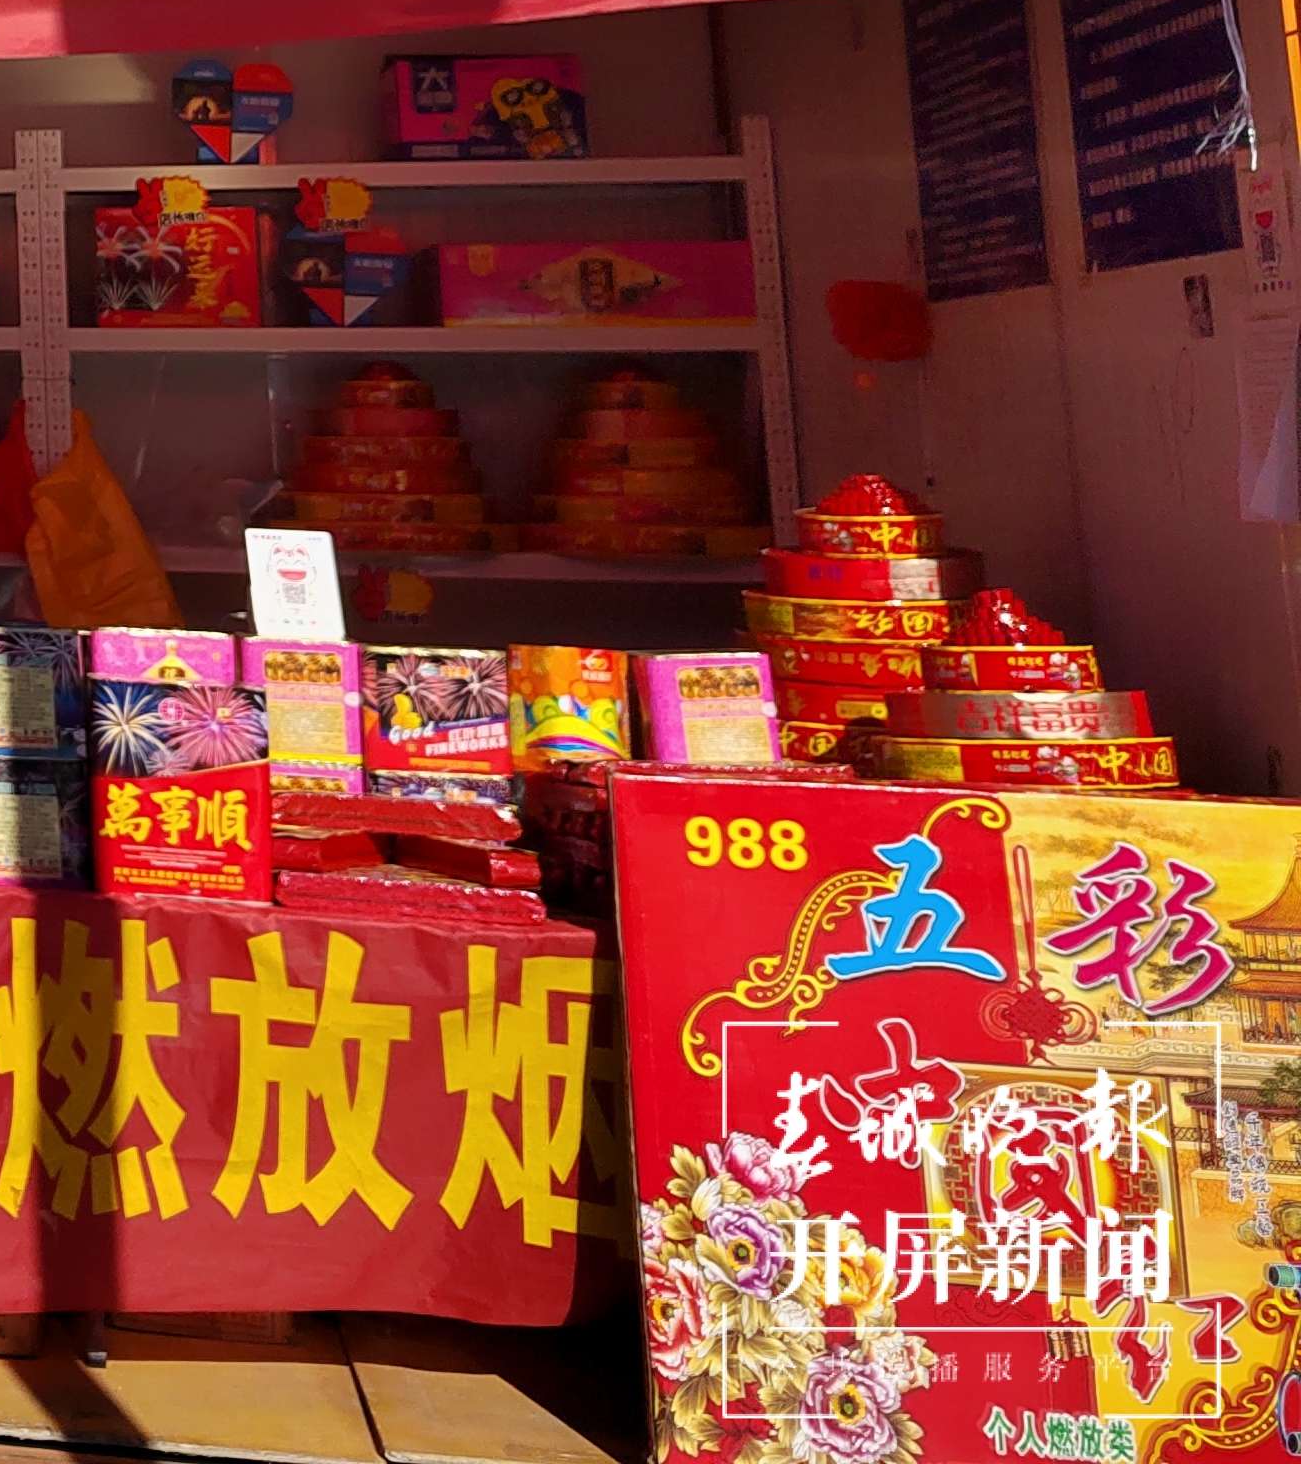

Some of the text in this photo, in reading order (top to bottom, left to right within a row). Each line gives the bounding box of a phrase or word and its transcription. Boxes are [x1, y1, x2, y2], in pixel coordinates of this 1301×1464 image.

[389, 722, 435, 745] Good
[957, 700, 1103, 734] 吉祥富贵
[425, 734, 509, 757] FIREWORKS
[683, 816, 809, 872] 988
[825, 834, 1236, 1015] 五彩
[983, 1405, 1136, 1463] 个人燃放类
